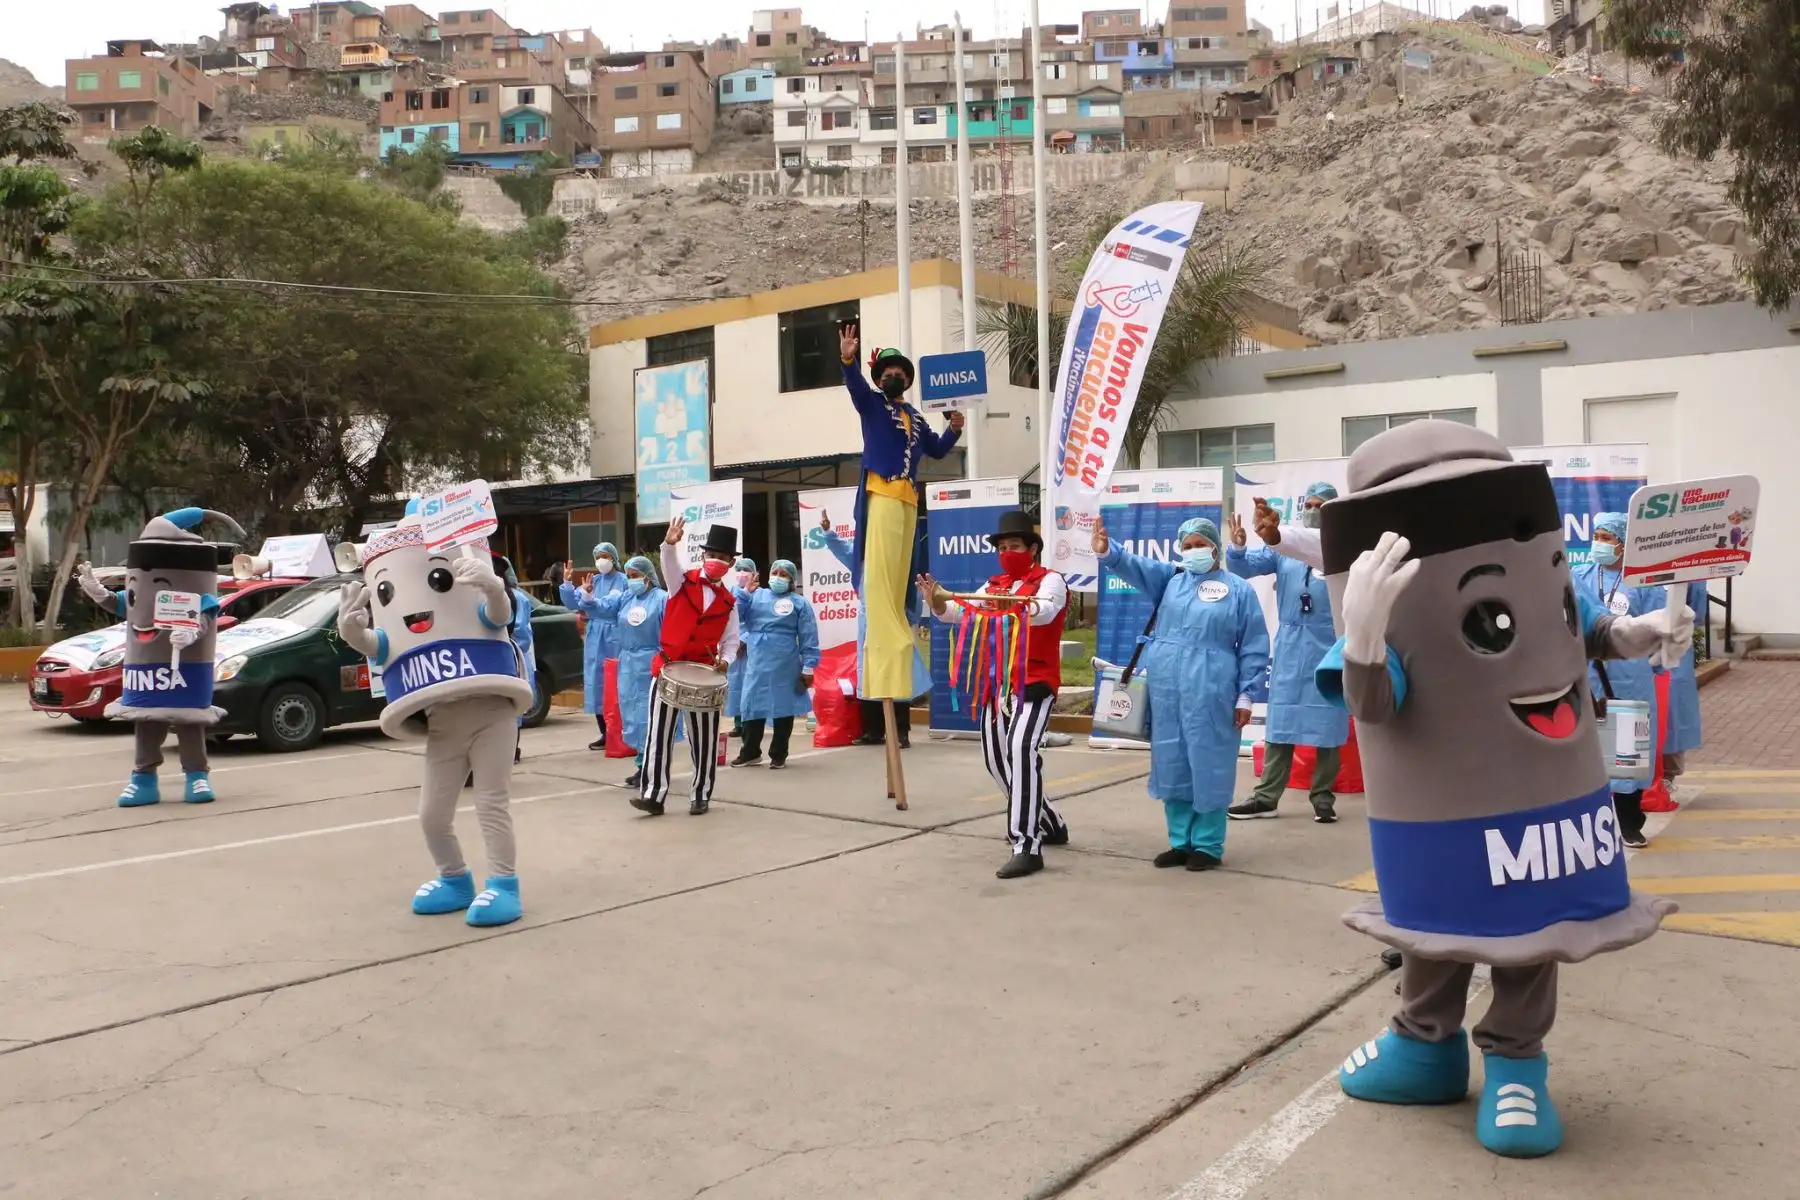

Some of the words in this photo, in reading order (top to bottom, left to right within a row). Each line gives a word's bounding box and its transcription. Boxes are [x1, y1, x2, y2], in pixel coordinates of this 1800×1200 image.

[930, 370, 978, 387] MINSA
[1099, 322, 1149, 423] Vamos
[1064, 321, 1117, 477] encuentro
[1091, 427, 1110, 450] a
[1081, 453, 1105, 488] tu
[1681, 489, 1730, 505] vacuno!
[1683, 488, 1703, 498] me
[1699, 500, 1726, 510] dosis
[688, 533, 709, 542] Pont
[803, 527, 828, 550] ¡S
[1634, 535, 1656, 544] Para
[1657, 527, 1699, 540] disfrutar
[1700, 524, 1711, 532] de
[1713, 523, 1726, 531] los
[939, 534, 998, 556] MINS
[1638, 540, 1673, 552] eventos
[1568, 551, 1596, 563] IMA
[810, 572, 851, 586] Ponte
[812, 589, 859, 604] tercer
[819, 603, 857, 621] dosis
[401, 648, 478, 692] MINSA
[123, 667, 188, 692] MINSA
